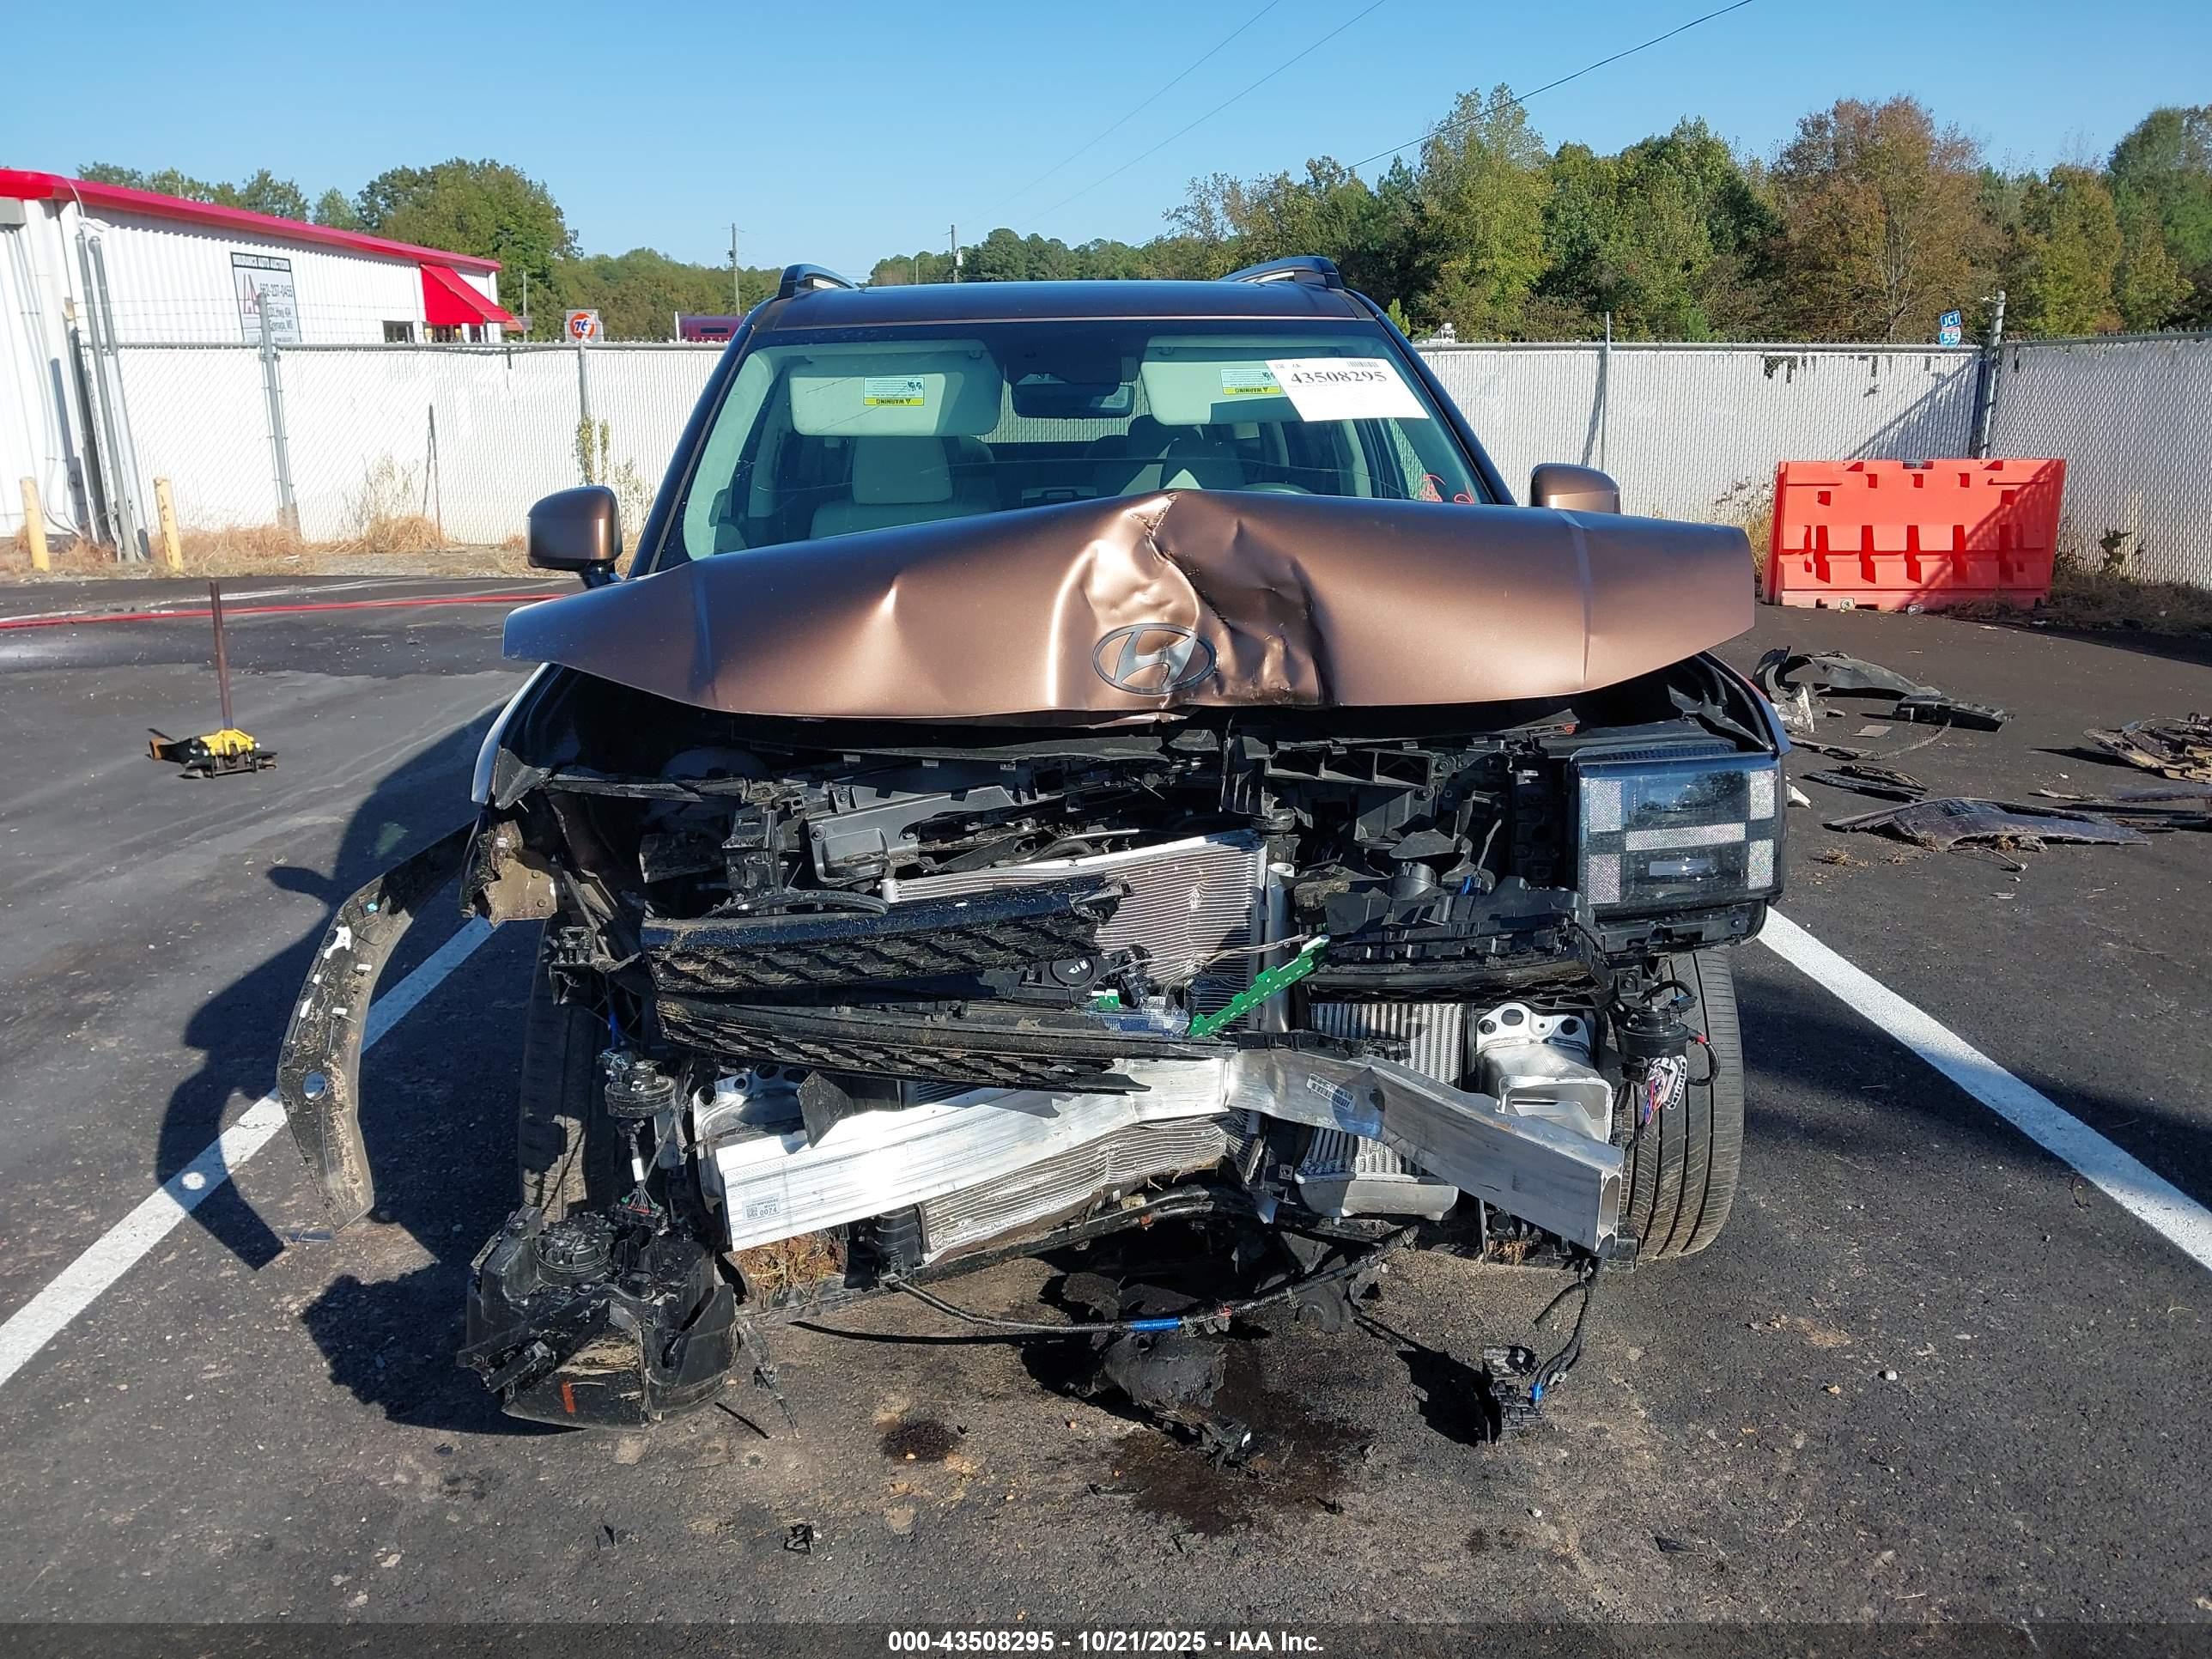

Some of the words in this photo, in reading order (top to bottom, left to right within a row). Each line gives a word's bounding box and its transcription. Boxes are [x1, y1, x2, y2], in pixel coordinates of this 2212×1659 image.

[1944, 313, 1959, 326] JCT
[1943, 333, 1959, 343] 55
[1291, 371, 1387, 384] 43508295
[760, 1206, 777, 1216] 0074
